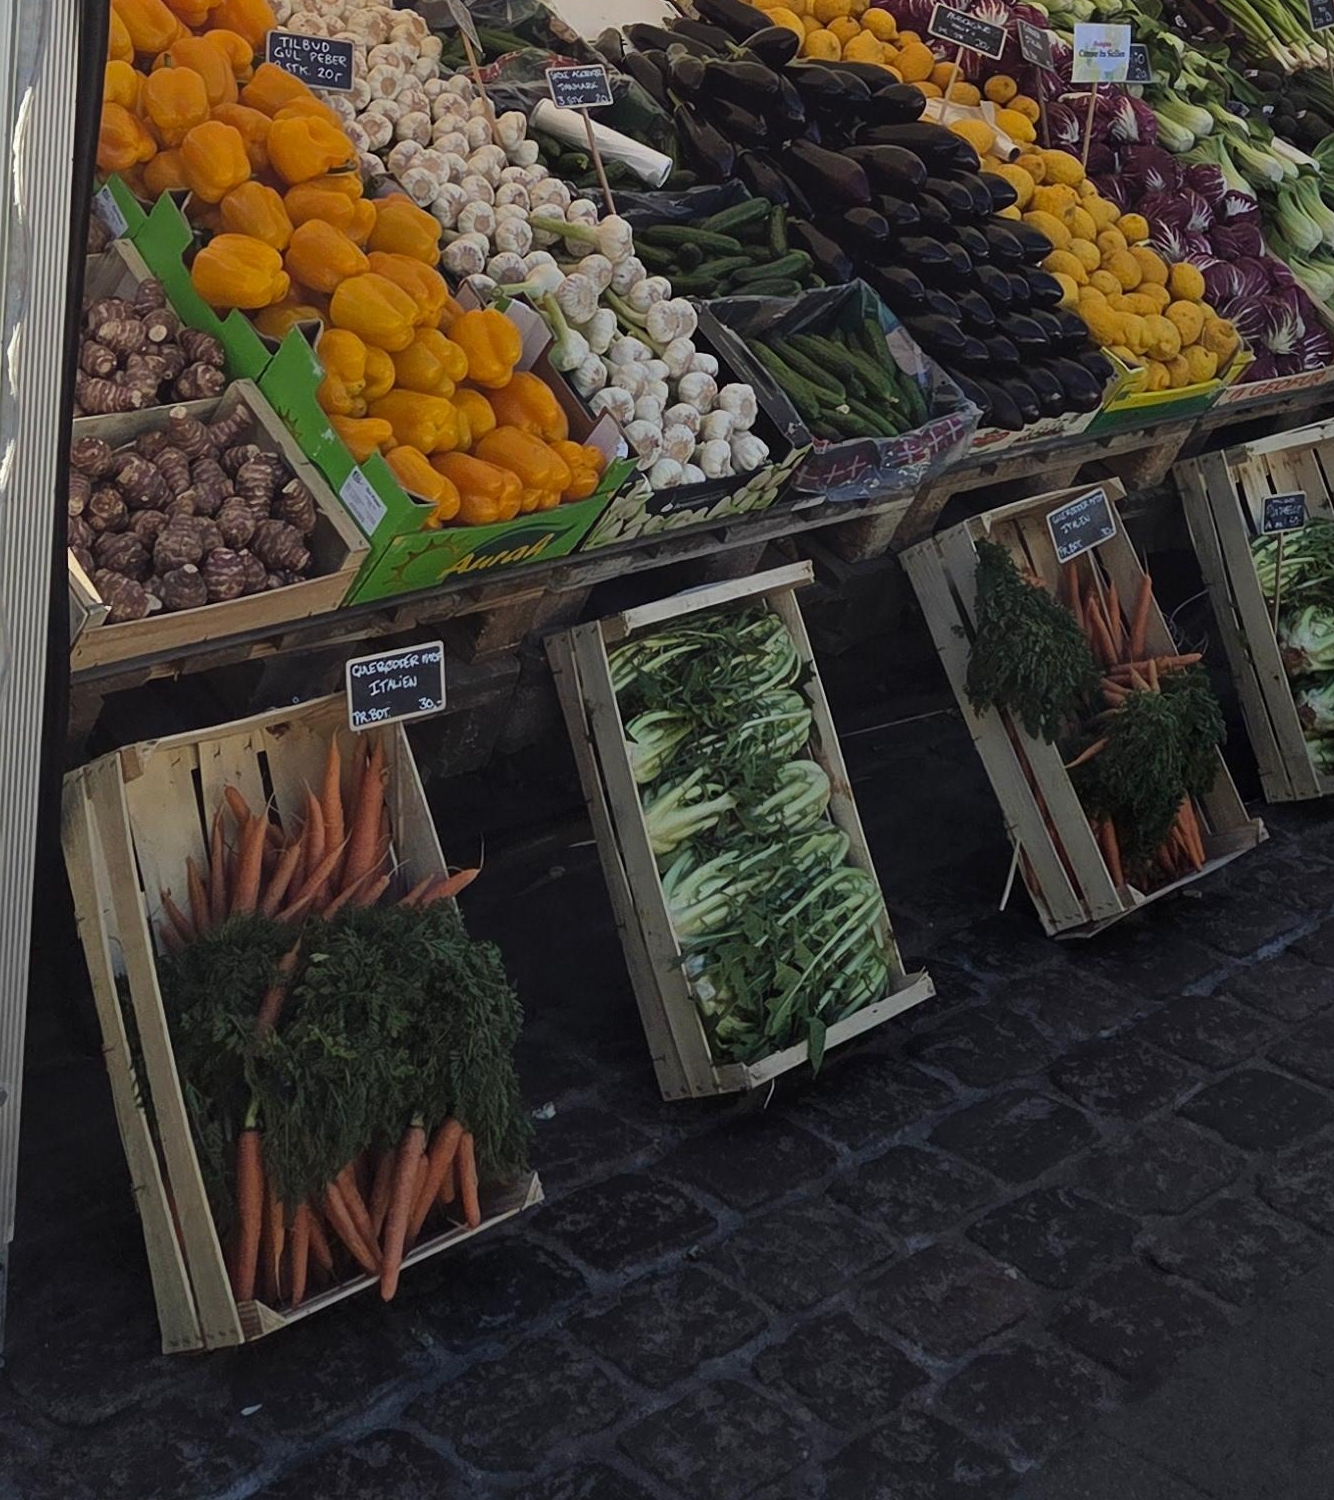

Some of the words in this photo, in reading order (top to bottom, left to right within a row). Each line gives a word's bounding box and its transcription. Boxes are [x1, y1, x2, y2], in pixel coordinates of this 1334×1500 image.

[278, 37, 330, 53] TILBUD
[274, 46, 301, 61] GUL
[309, 52, 347, 68] PEBER
